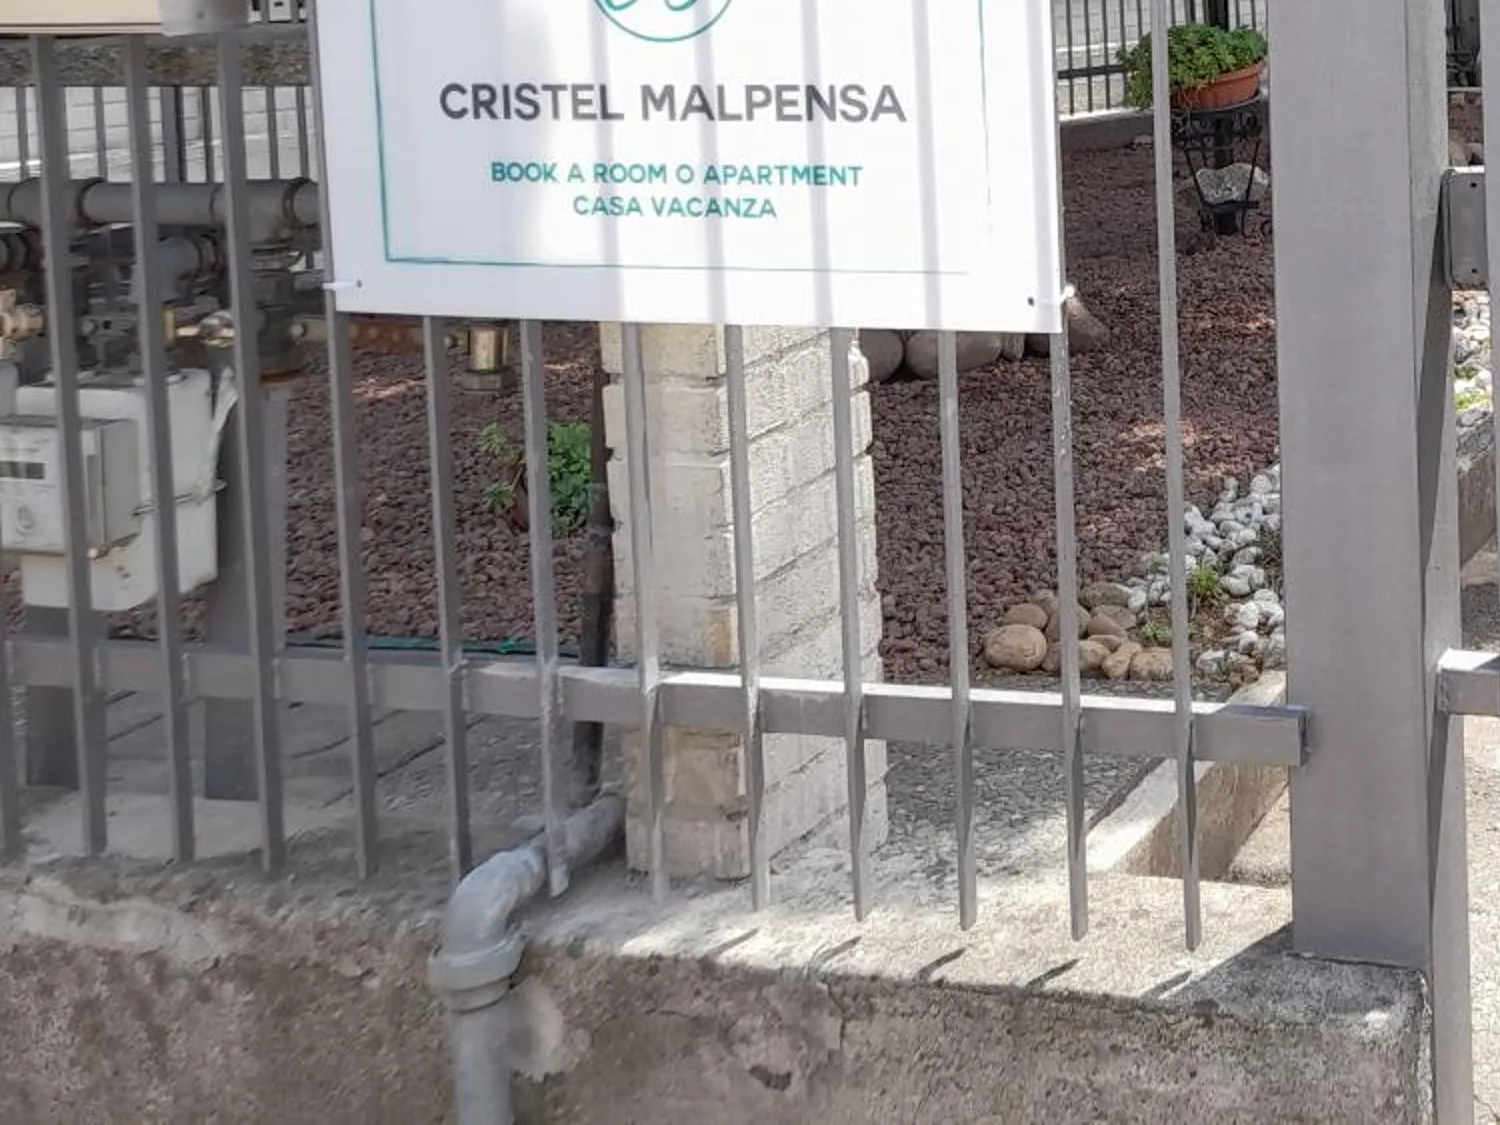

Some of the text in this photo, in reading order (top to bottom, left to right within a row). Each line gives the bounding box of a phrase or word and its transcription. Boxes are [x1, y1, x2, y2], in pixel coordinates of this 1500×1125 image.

[439, 82, 908, 123] CRISTEL MALPENSA
[491, 161, 863, 187] BOOK A ROOM O APARTMENT
[573, 195, 778, 219] CASA VACANZA
